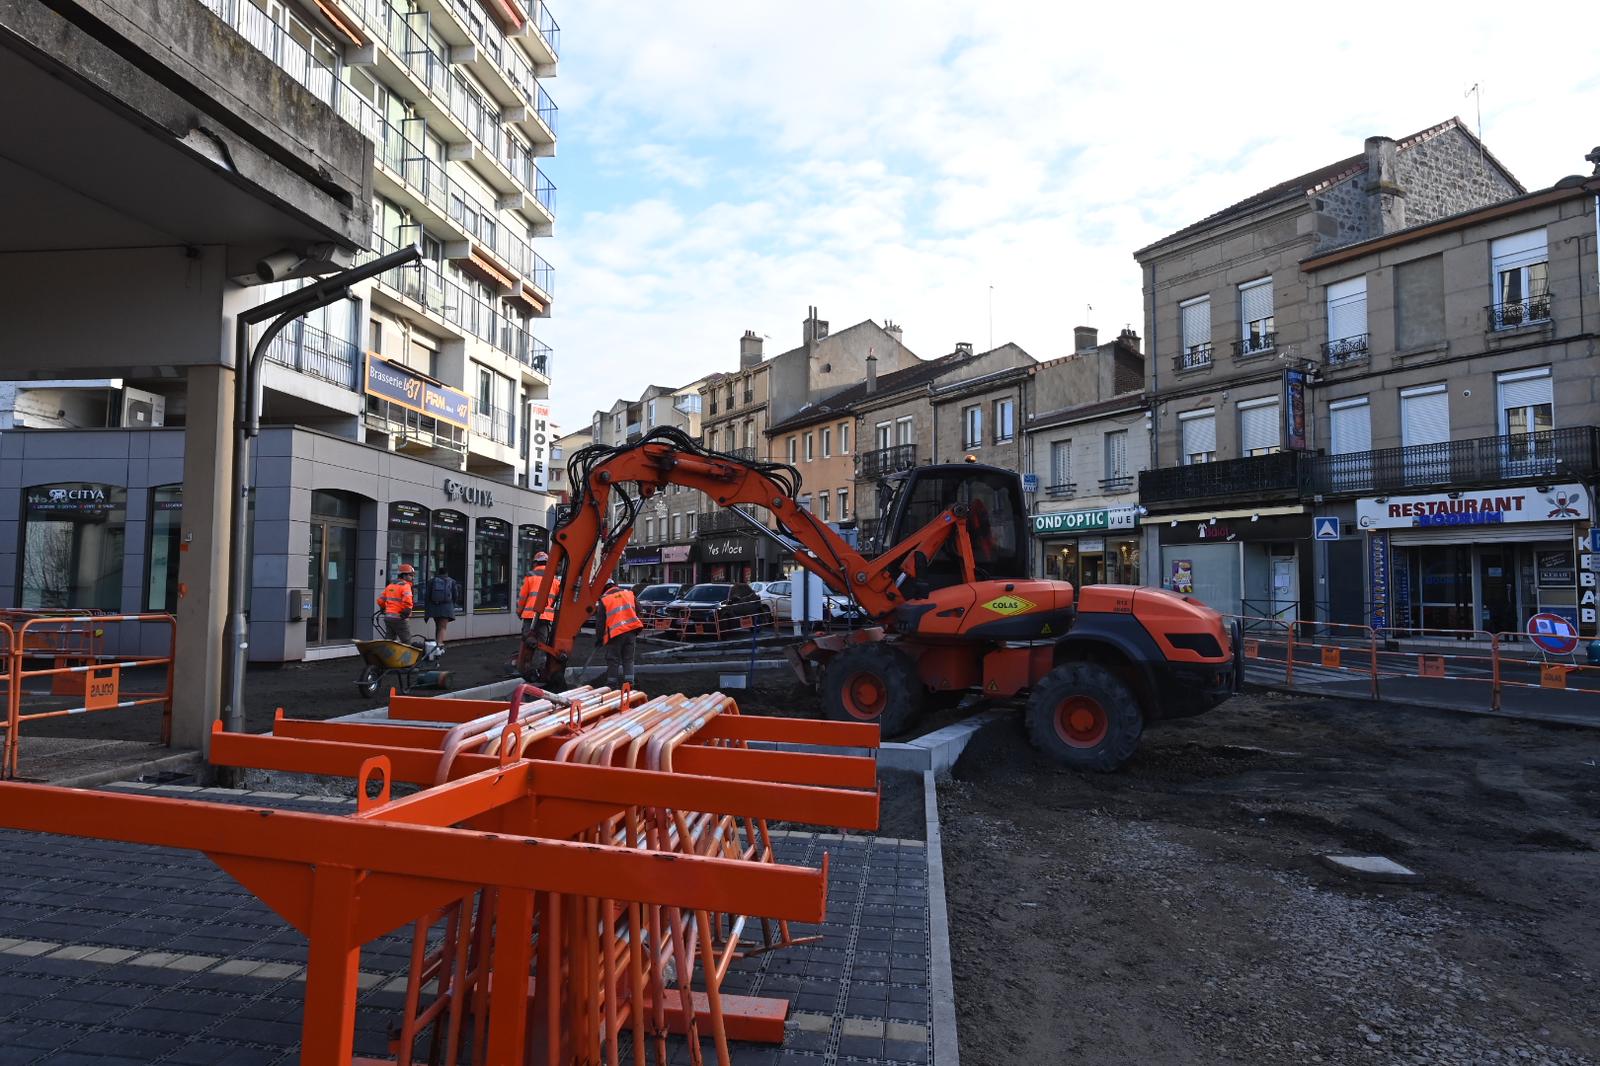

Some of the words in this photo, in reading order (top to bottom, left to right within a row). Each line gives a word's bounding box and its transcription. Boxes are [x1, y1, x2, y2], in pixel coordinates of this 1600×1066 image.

[369, 365, 403, 389] Brasserie
[533, 418, 547, 488] HOTEL
[68, 488, 105, 499] CITYA
[1388, 495, 1526, 518] RESTAURANT
[1035, 511, 1105, 530] OND'OPTIC
[1109, 515, 1132, 525] VUE
[708, 543, 719, 556] Yes
[721, 540, 744, 555] Mode
[1577, 536, 1597, 623] KEBAB
[992, 601, 1019, 609] COLAS
